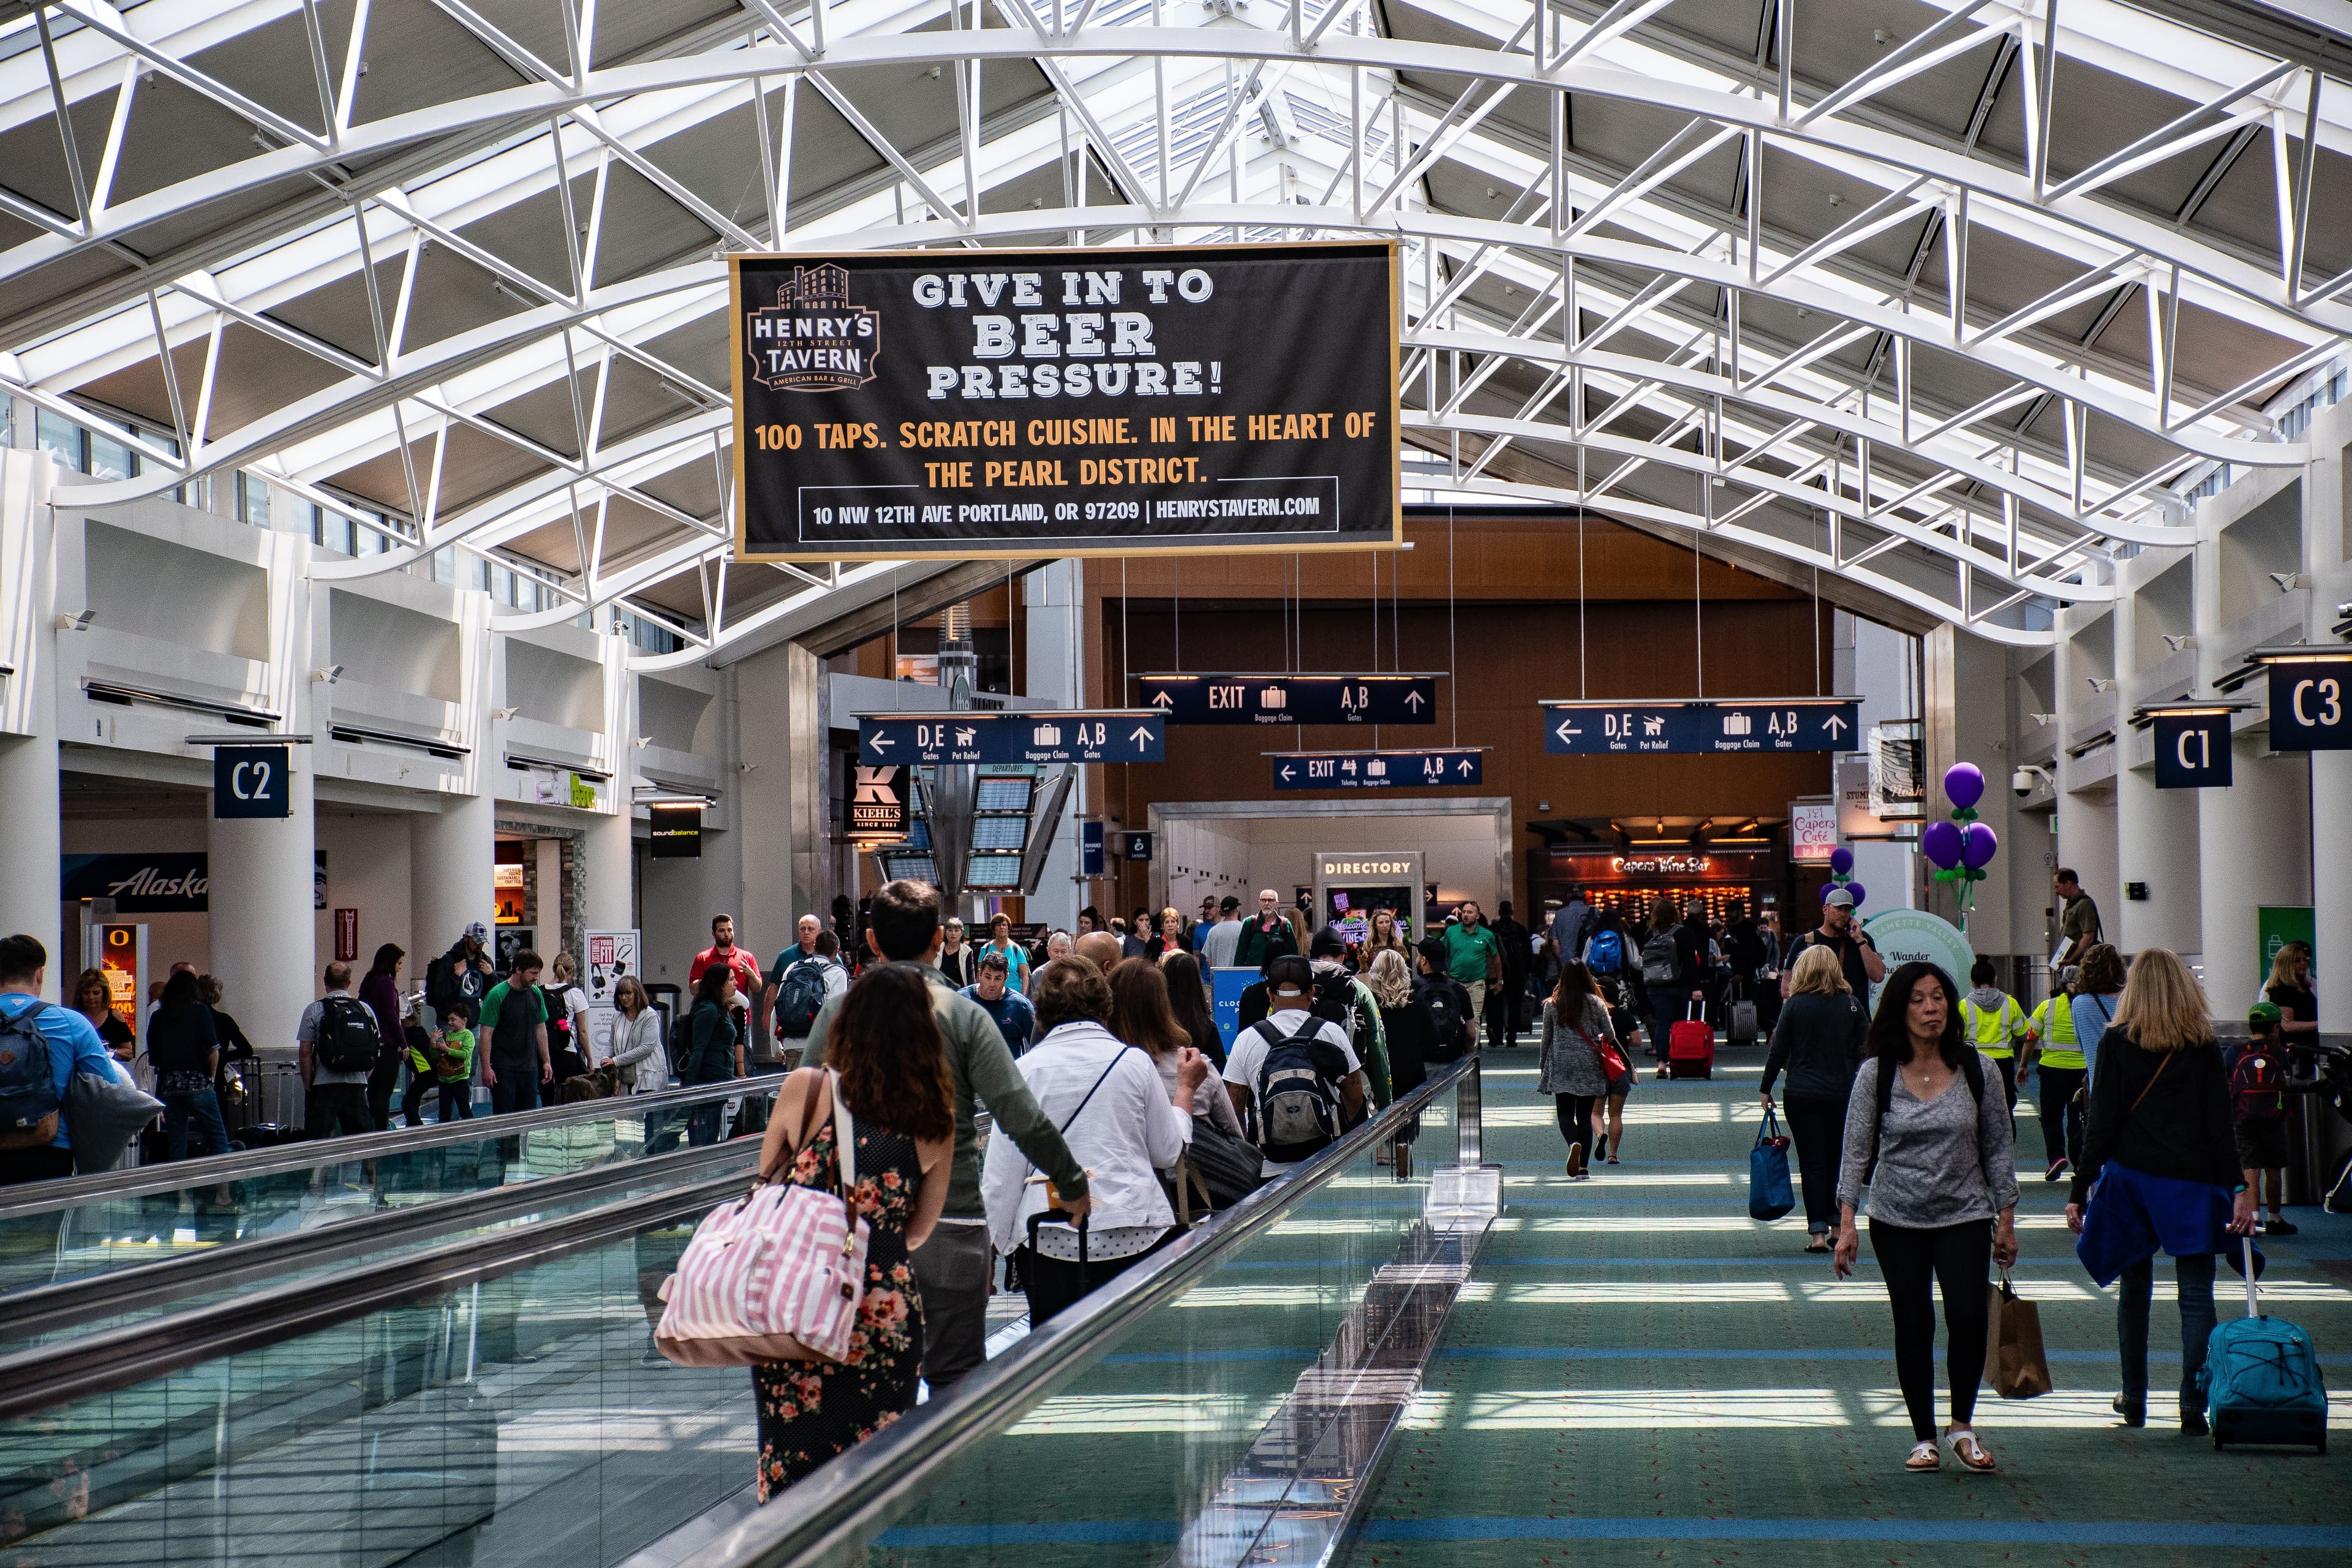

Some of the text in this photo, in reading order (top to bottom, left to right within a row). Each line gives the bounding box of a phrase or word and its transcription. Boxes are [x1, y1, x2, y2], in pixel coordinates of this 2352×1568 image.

[913, 269, 1213, 307] GIVE IN TO
[755, 314, 873, 338] HENRY'S
[973, 312, 1156, 358] BEER
[766, 349, 860, 373] TAVERN
[774, 375, 812, 386] AMERICAN
[927, 361, 1221, 399] PRESSURE!
[755, 412, 1376, 450] 100 TAPS. SCRATCH CUISINE. IN THE HEART OF
[924, 457, 1207, 488] THE PEARL DISTRICT.
[813, 497, 1320, 525] 10 NW 12TH AVE PORTLAND, OR 97209 HENRYSTAVERN.COM
[1209, 686, 1368, 713] EXIT A,B
[2293, 679, 2342, 727] C3
[1255, 714, 1277, 723] Baggage
[1605, 712, 1798, 741] D,E A,B
[918, 723, 1106, 752] D,E A,B
[1610, 741, 1627, 750] Gates
[1651, 741, 1669, 749] Relief
[1715, 741, 1741, 750] Baggage
[2177, 729, 2209, 769] C1
[922, 752, 939, 760] Gates
[963, 751, 980, 760] Relief
[1025, 751, 1051, 761] Baggage
[1053, 750, 1069, 759] Claim
[1309, 757, 1444, 777] EXIT A,B
[232, 761, 271, 799] C2
[853, 809, 900, 818] KIEHL'S
[1795, 817, 1835, 831] Capers
[1803, 831, 1828, 843] Café
[1325, 862, 1411, 874] DIRECTORY
[1613, 856, 1710, 873] Capers Wine Bar
[108, 867, 208, 898] Alaska
[1329, 919, 1368, 930] Welcome
[601, 946, 612, 962] FIT
[1890, 951, 1930, 960] Wander
